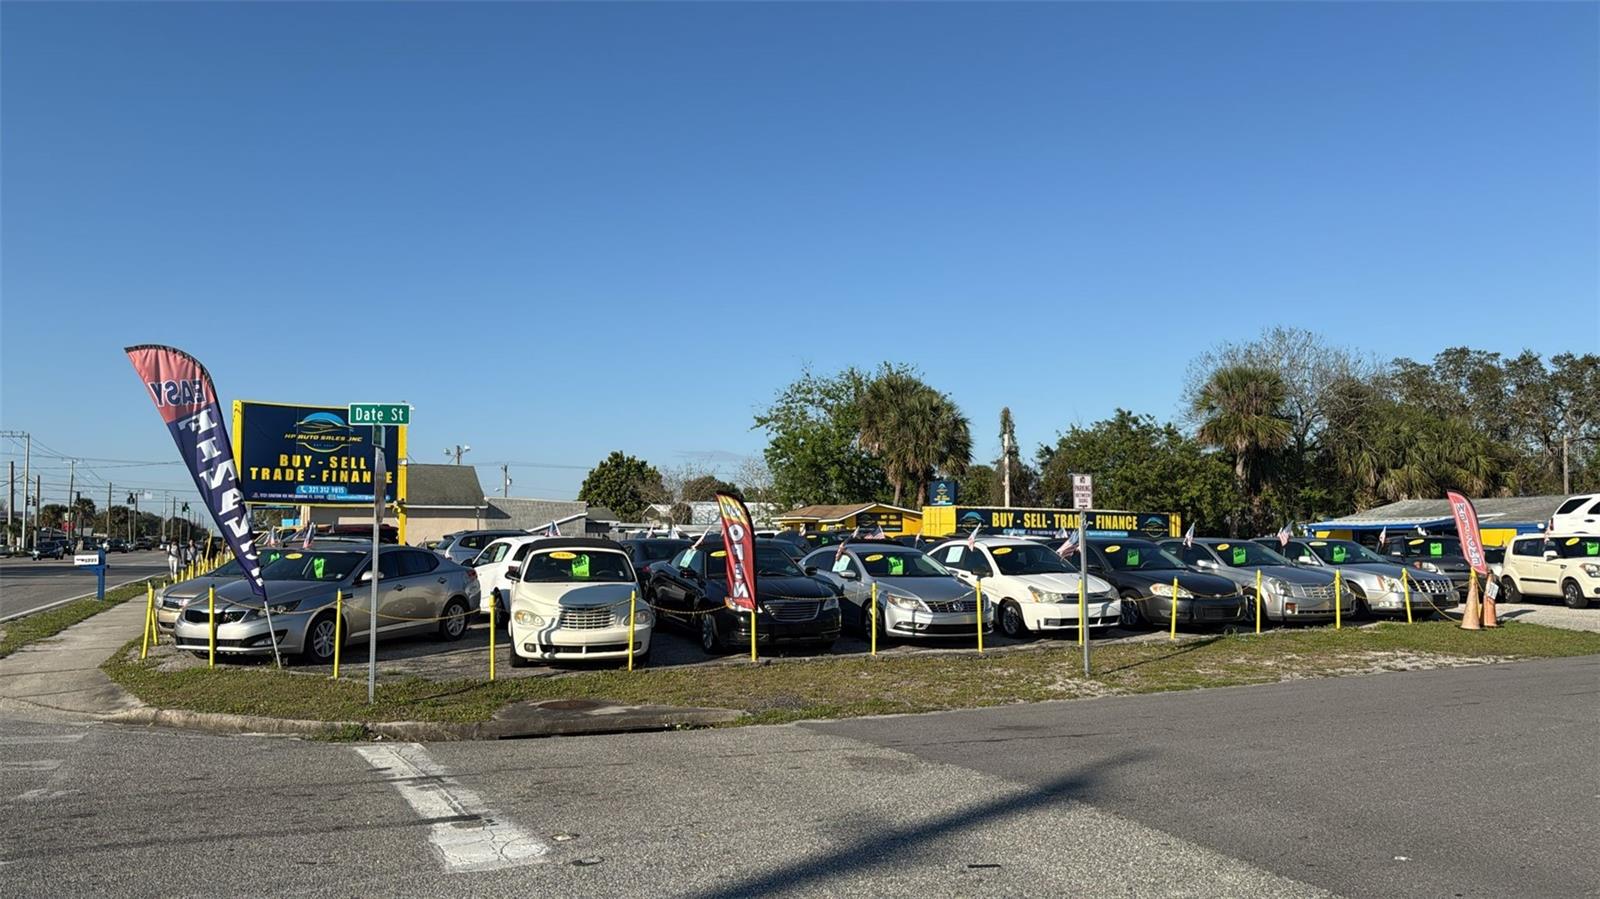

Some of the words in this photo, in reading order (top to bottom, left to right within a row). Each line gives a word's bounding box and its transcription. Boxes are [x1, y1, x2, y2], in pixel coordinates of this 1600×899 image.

[355, 407, 384, 422] Date
[391, 407, 404, 422] St
[279, 454, 312, 468] BUY
[329, 456, 367, 469] SELL
[250, 467, 305, 482] TRADE
[322, 470, 393, 484] FINANE
[992, 512, 1014, 528] BUY
[1054, 513, 1083, 529] TRAD
[1096, 515, 1138, 531] FINANCE
